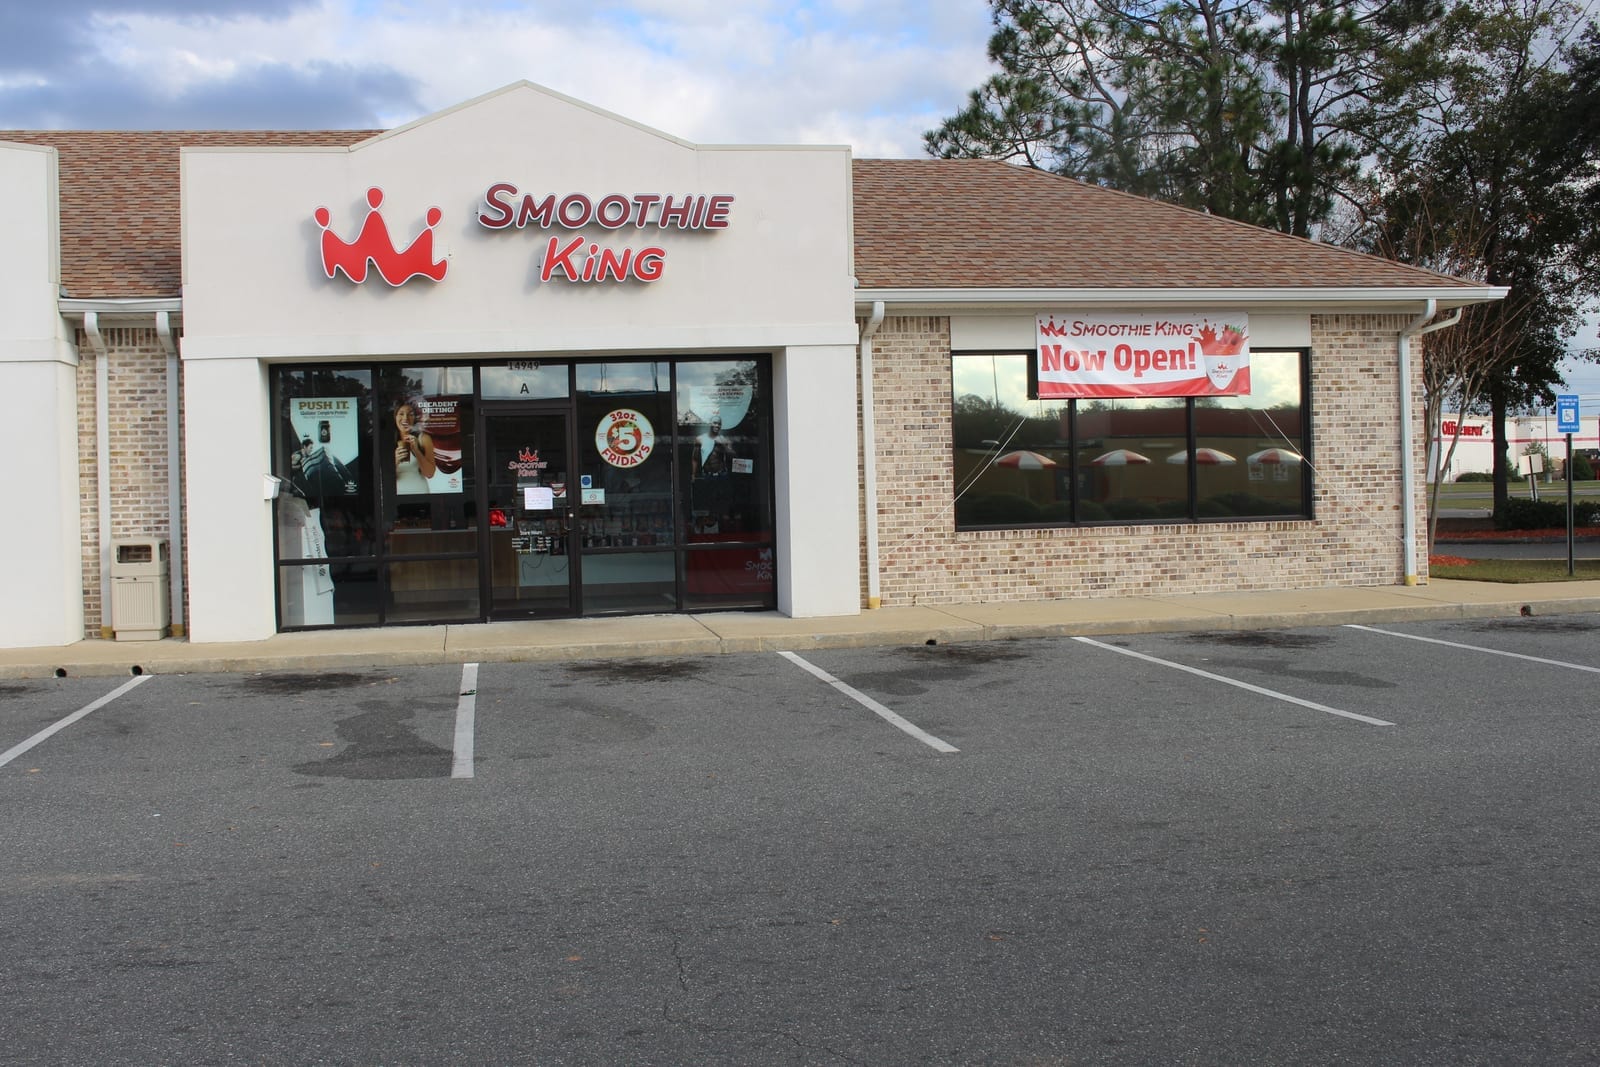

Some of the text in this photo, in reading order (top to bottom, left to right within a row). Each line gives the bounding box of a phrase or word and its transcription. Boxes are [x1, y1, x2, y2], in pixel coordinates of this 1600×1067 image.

[478, 182, 735, 229] SMOOTHIE
[1070, 320, 1151, 337] SMOOTHIE
[508, 360, 540, 370] 14949
[1113, 342, 1197, 377] Open!
[520, 383, 530, 394] A
[298, 401, 333, 410] PUSH
[610, 411, 637, 421] 32oz.
[602, 445, 650, 466] FRIDAYS
